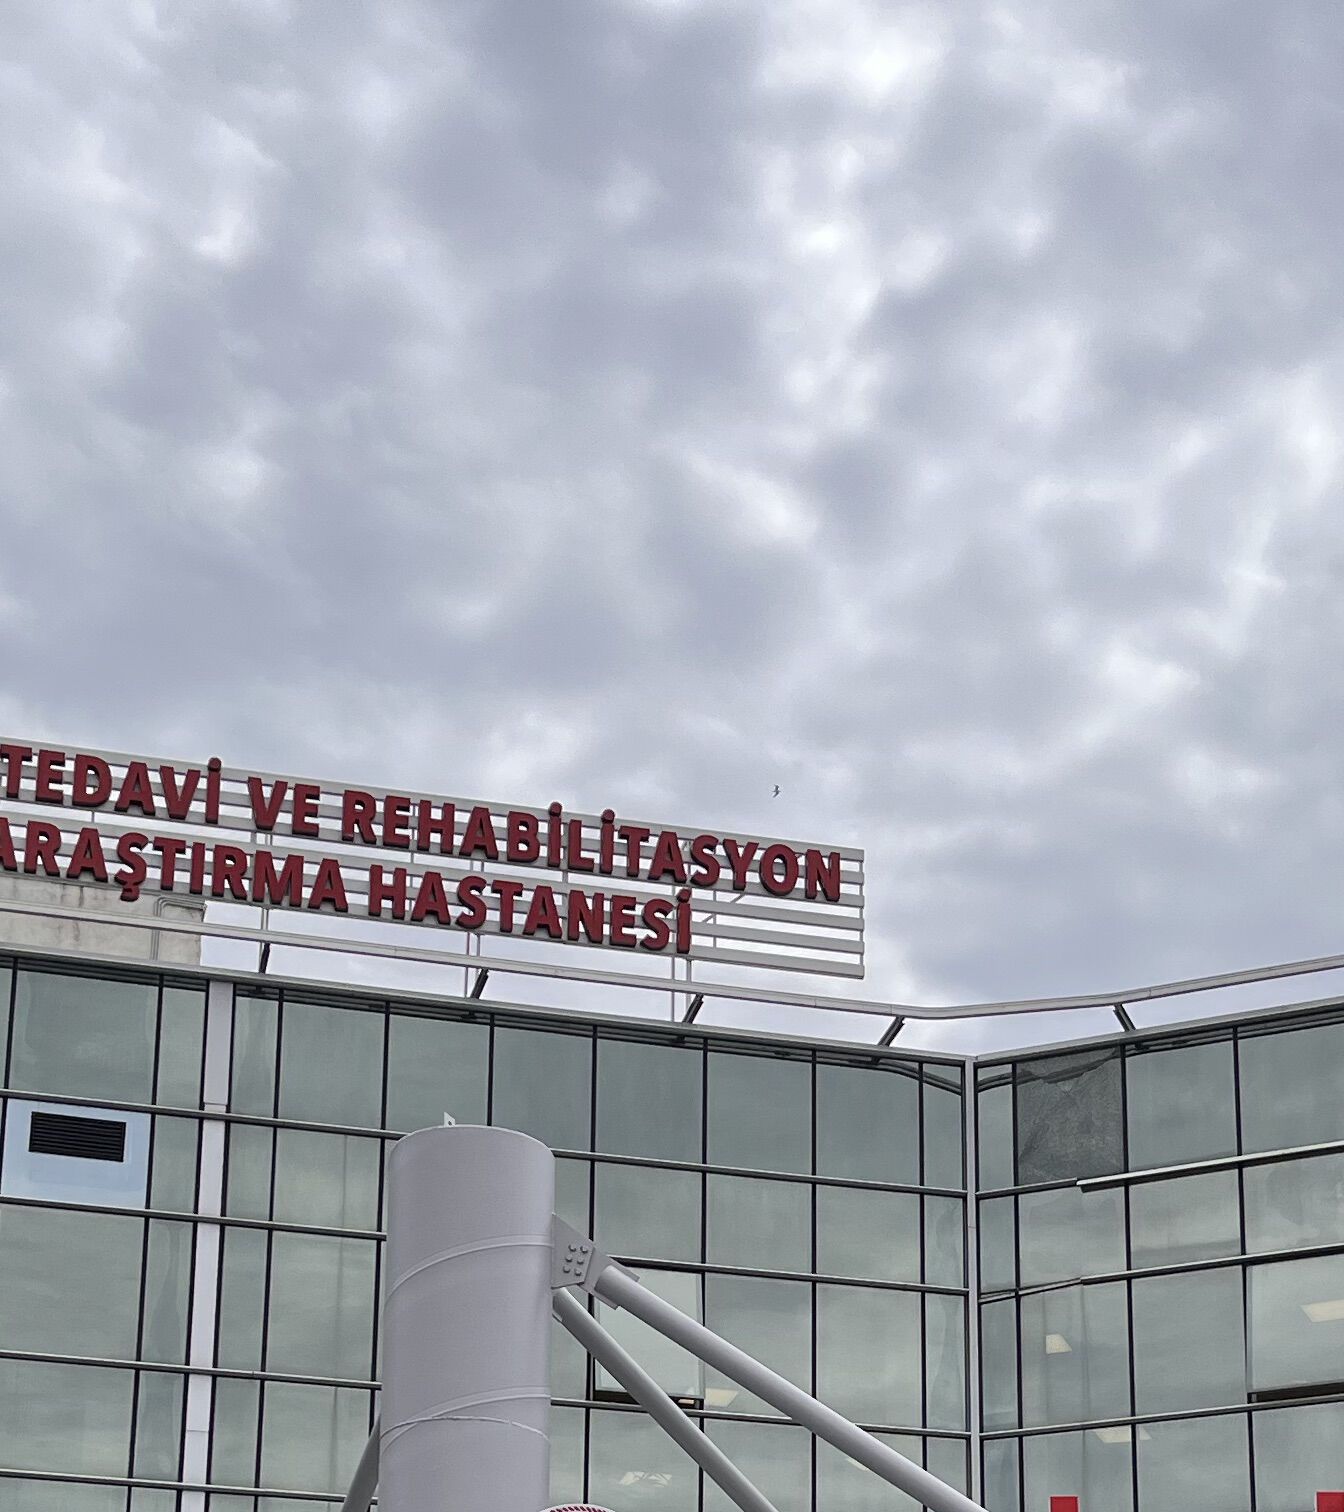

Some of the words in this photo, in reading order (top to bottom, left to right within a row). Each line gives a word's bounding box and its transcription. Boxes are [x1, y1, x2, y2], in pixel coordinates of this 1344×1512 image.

[0, 743, 222, 824] TEDAVİ
[247, 776, 322, 838] VE
[342, 789, 842, 902] REHABİLİTASYON
[368, 864, 693, 954] HASTANESİ
